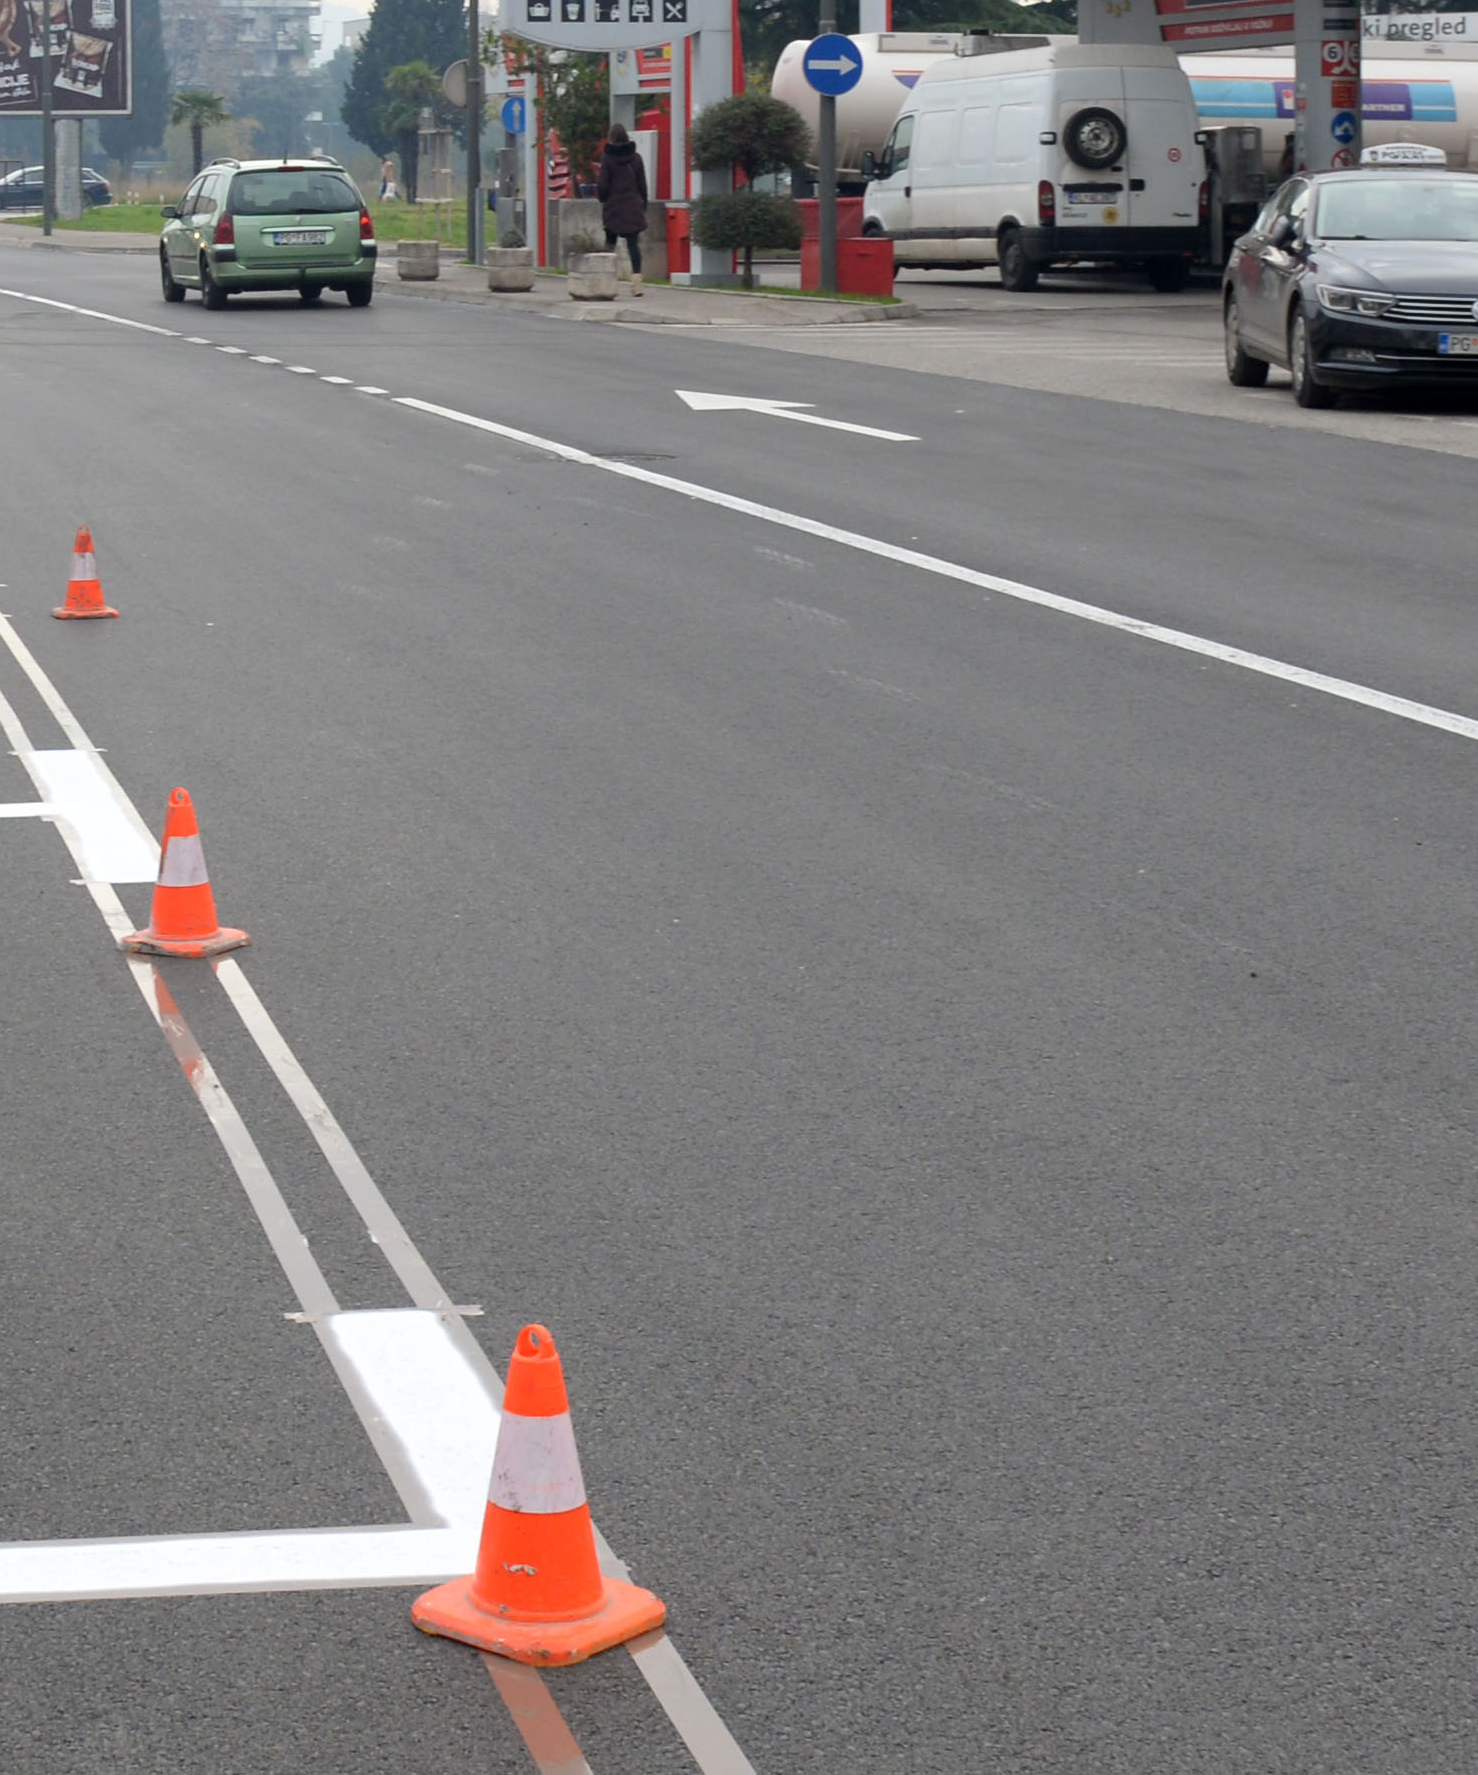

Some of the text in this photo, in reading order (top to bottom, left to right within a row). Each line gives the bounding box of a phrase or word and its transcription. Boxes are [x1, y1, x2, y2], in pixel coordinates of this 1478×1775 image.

[1387, 17, 1467, 41] pregled
[1328, 46, 1338, 59] 6
[1451, 337, 1471, 352] PG
